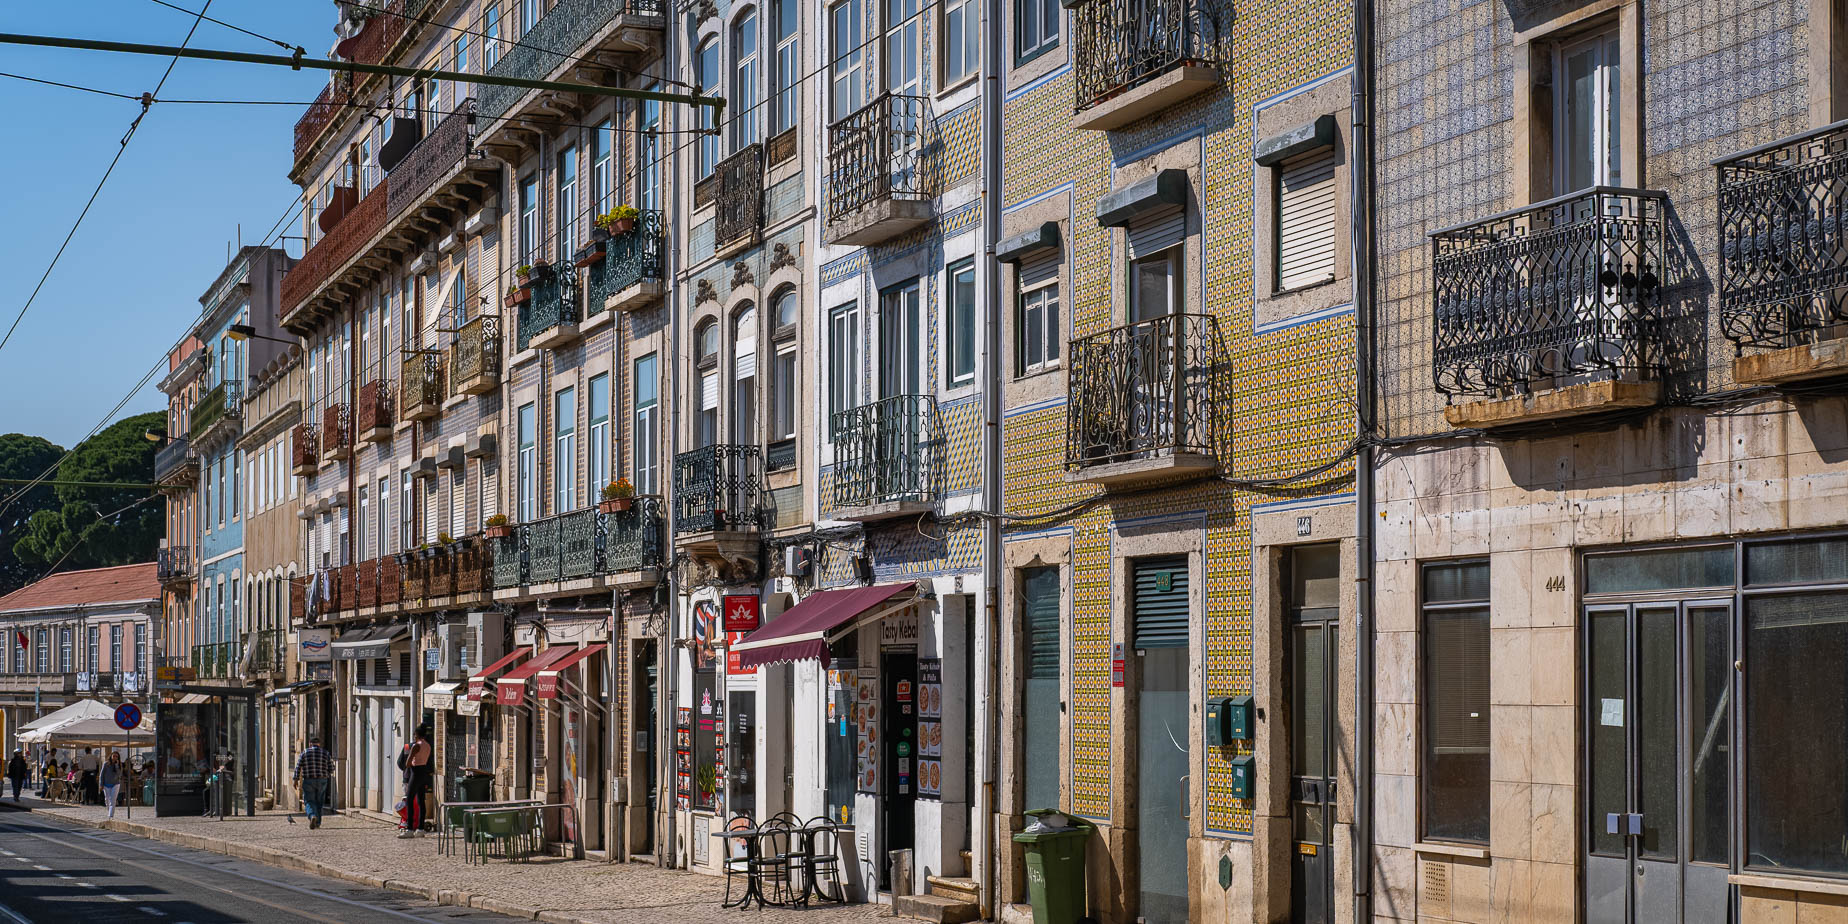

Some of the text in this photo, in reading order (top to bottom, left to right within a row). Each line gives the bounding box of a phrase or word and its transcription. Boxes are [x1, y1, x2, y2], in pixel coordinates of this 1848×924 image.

[1297, 517, 1310, 535] 446
[1157, 574, 1169, 587] 448
[1545, 575, 1566, 593] 444
[882, 621, 898, 643] Tasty
